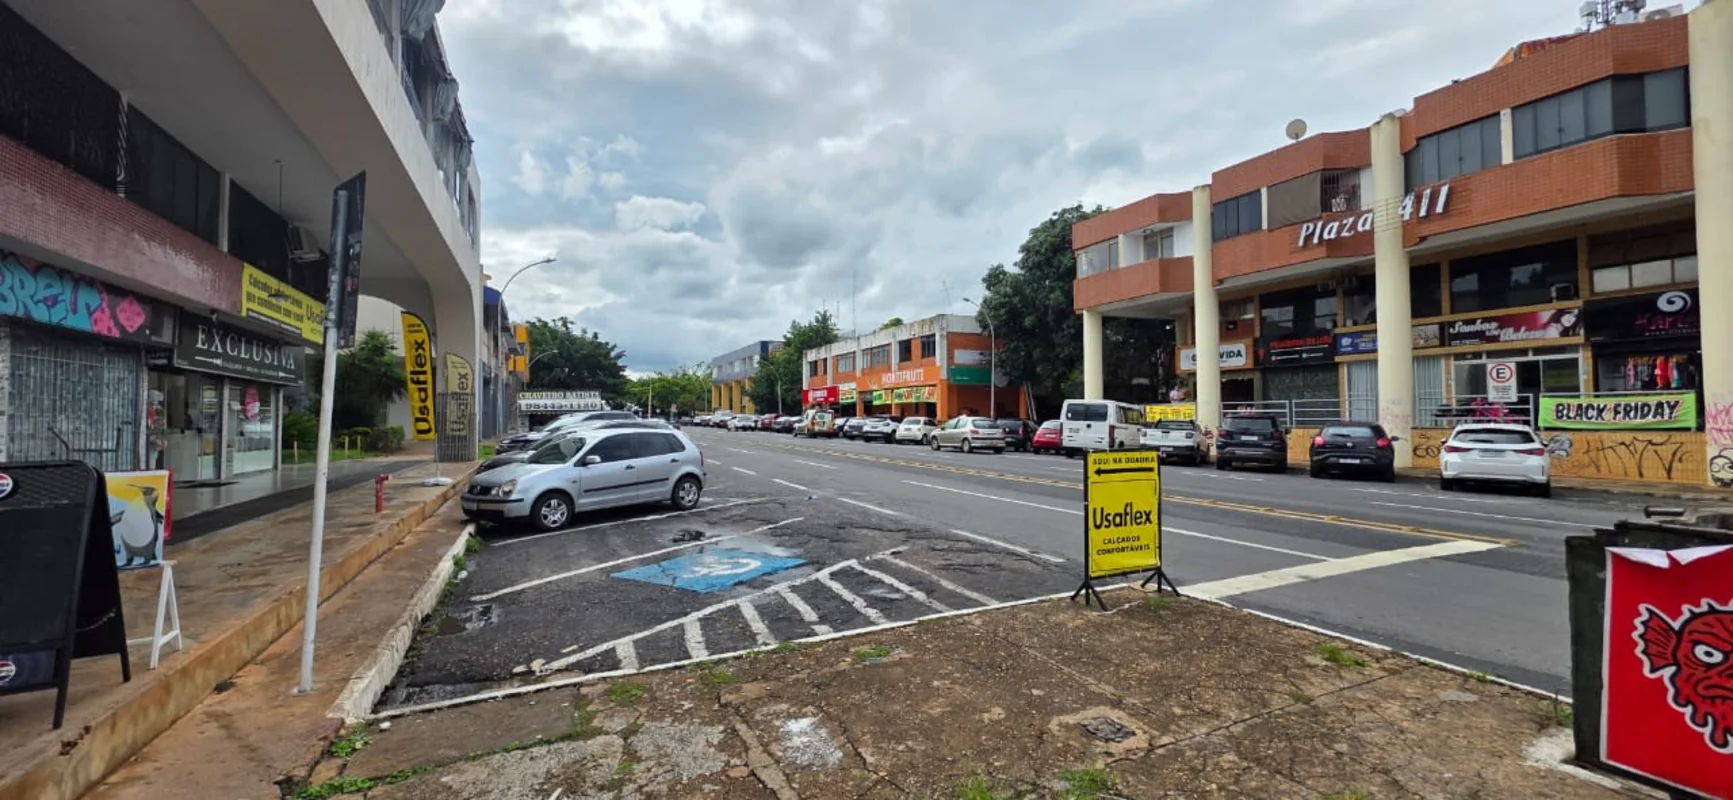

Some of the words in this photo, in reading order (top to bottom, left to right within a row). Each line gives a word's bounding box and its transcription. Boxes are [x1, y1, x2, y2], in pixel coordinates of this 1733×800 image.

[1298, 212, 1374, 247] Plaza
[1398, 184, 1449, 221] 411
[195, 324, 296, 370] EXCLUSIVA
[1219, 349, 1244, 360] VIDA
[1496, 367, 1506, 380] E
[409, 338, 433, 435] Usaflex
[519, 391, 564, 400] CHAVEIRO
[1555, 402, 1607, 421] BLACK
[1612, 400, 1680, 421] FRIDAY
[1093, 501, 1153, 530] Usaflex
[1102, 535, 1140, 545] CALÇADOS
[1096, 543, 1150, 556] CONFORTÁVEIS
